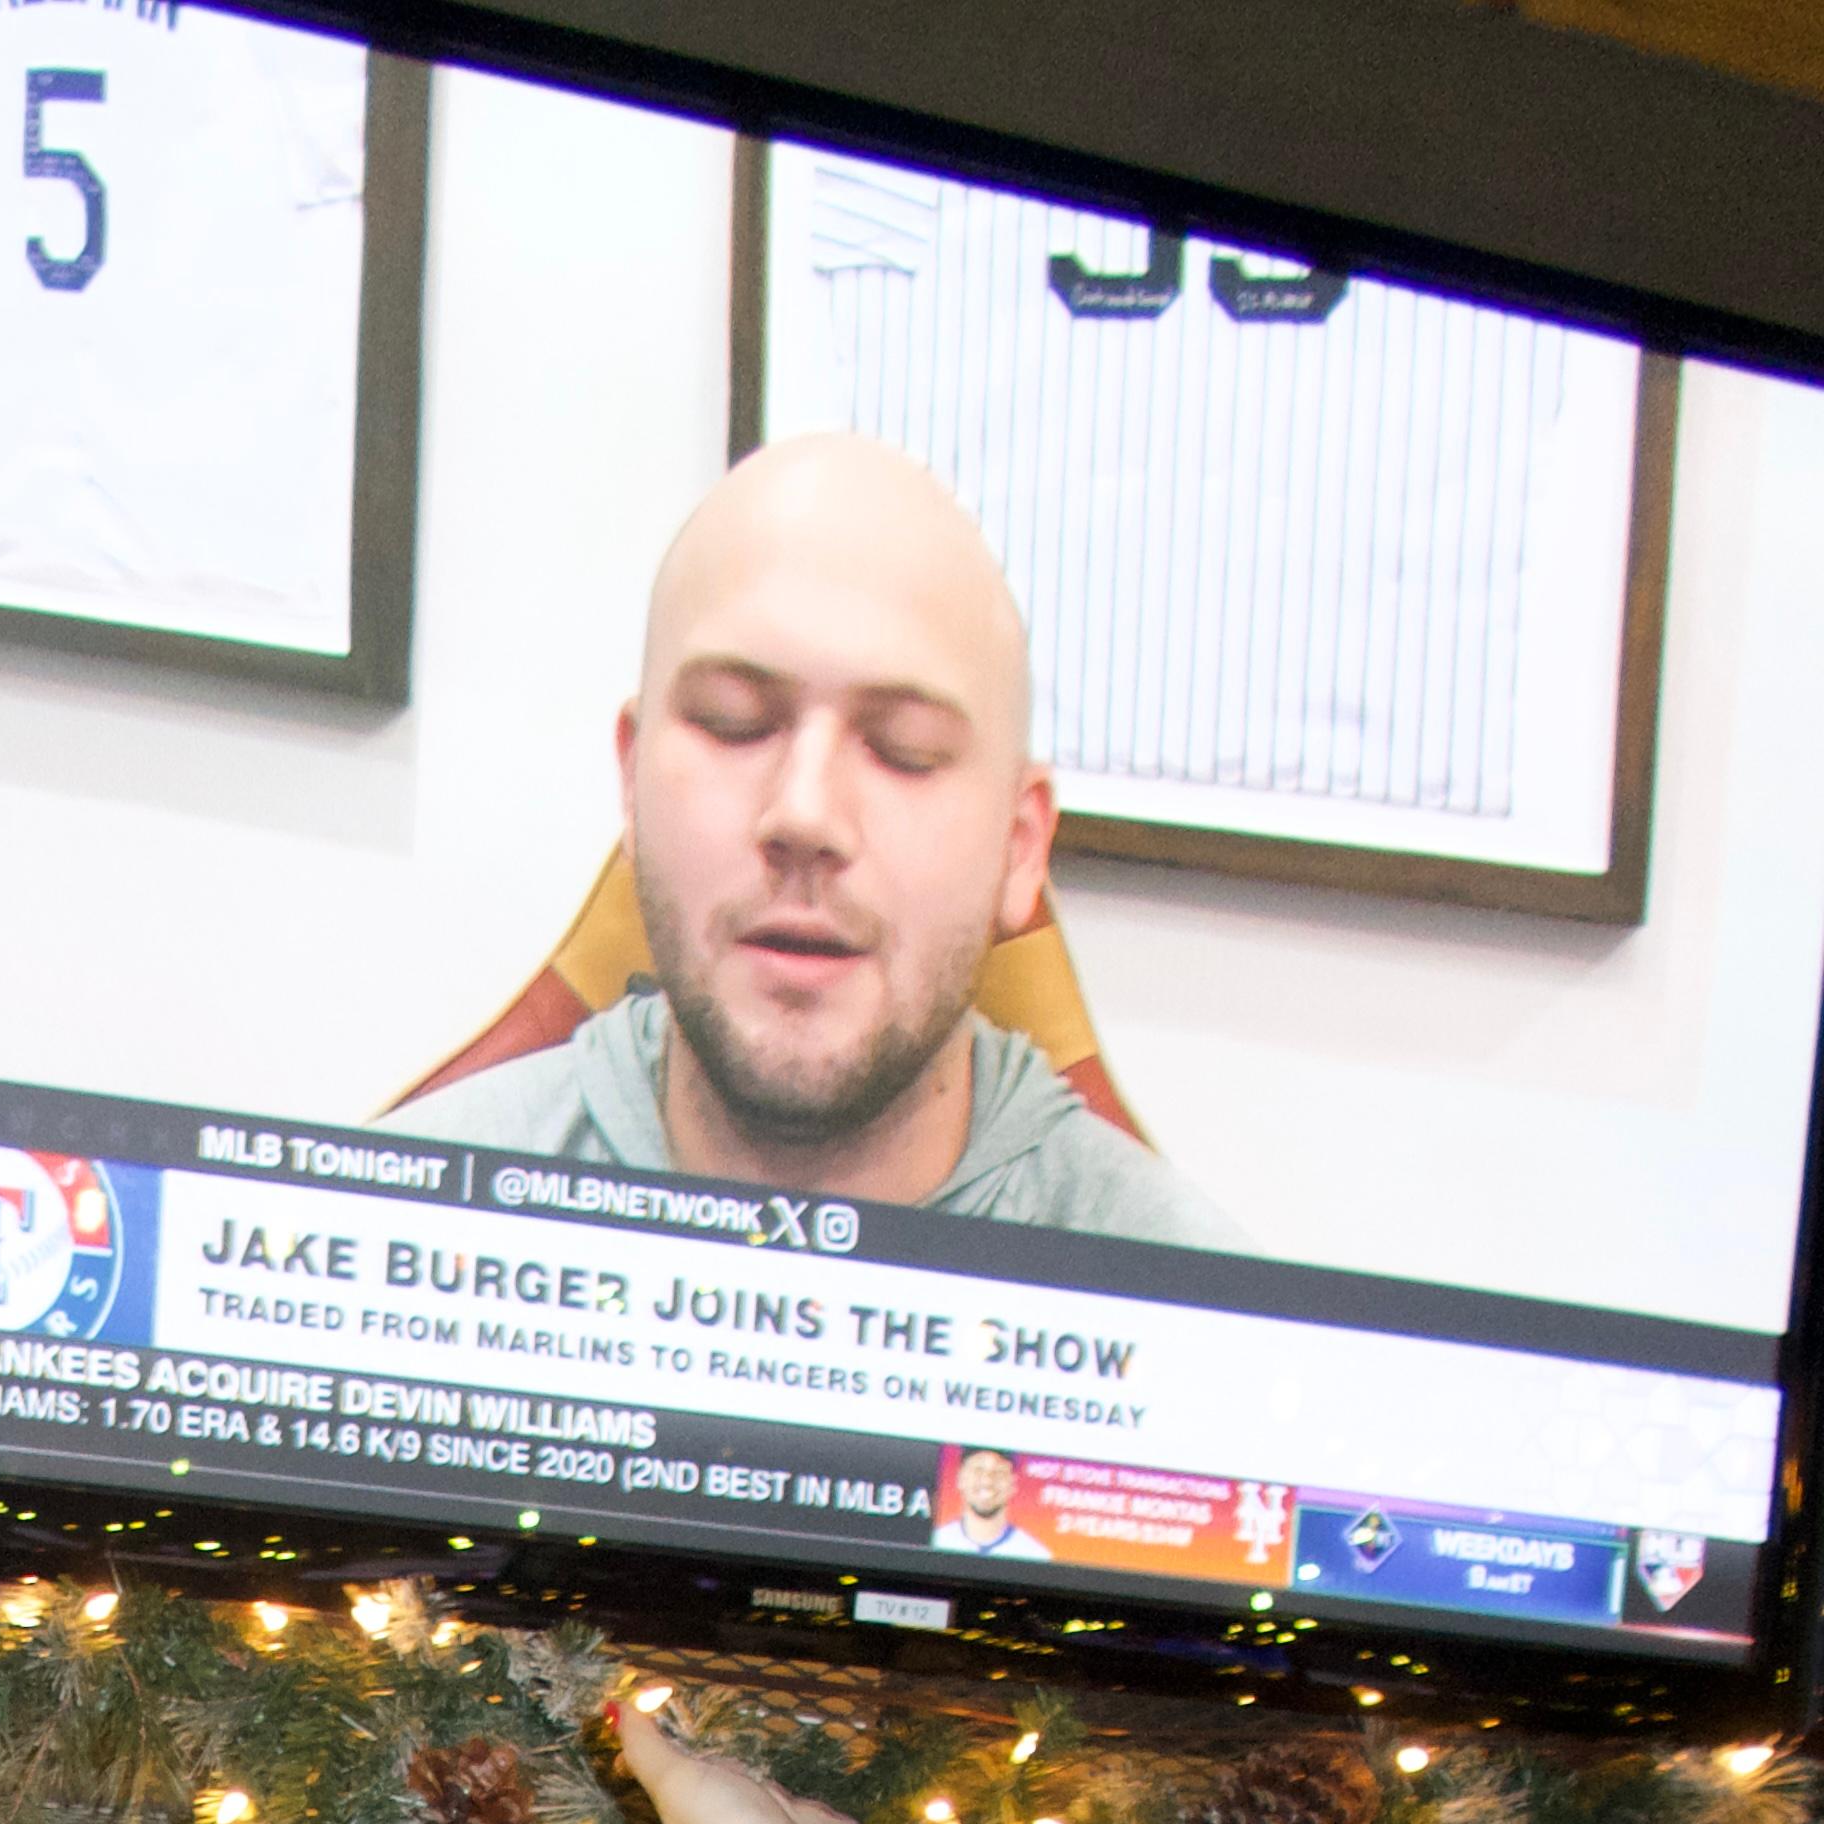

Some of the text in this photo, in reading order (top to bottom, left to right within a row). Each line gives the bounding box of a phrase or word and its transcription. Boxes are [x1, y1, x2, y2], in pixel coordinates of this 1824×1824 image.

[25, 67, 107, 292] 5
[199, 1125, 282, 1167] MLB
[290, 1138, 447, 1189] TONIGHT
[493, 1168, 763, 1234] @MLBNETWORK
[201, 1218, 1136, 1380] JAKE BURGER JOINS THE SHOW
[146, 1357, 335, 1412] ACQUIRE
[341, 1379, 462, 1426] DEVIN
[470, 1394, 656, 1450] WILLIAMS
[199, 1287, 1147, 1430] TRADED FROM MARLINS TO RANGERS ON WEDNESDAY
[98, 1398, 172, 1434] 1.70
[178, 1405, 251, 1443] ERA
[256, 1415, 282, 1447] &
[291, 1419, 361, 1456] 14.6
[366, 1428, 423, 1464] K/9
[427, 1433, 530, 1479] SINCE
[535, 1447, 615, 1484] 2020
[621, 1456, 701, 1495] (2ND
[706, 1466, 791, 1506] BEST
[796, 1478, 832, 1508] IN
[836, 1480, 905, 1516] MLB
[752, 1588, 843, 1613] SAMSUNG
[1432, 1529, 1575, 1571] WEEKDAYS
[876, 1600, 897, 1617] TV
